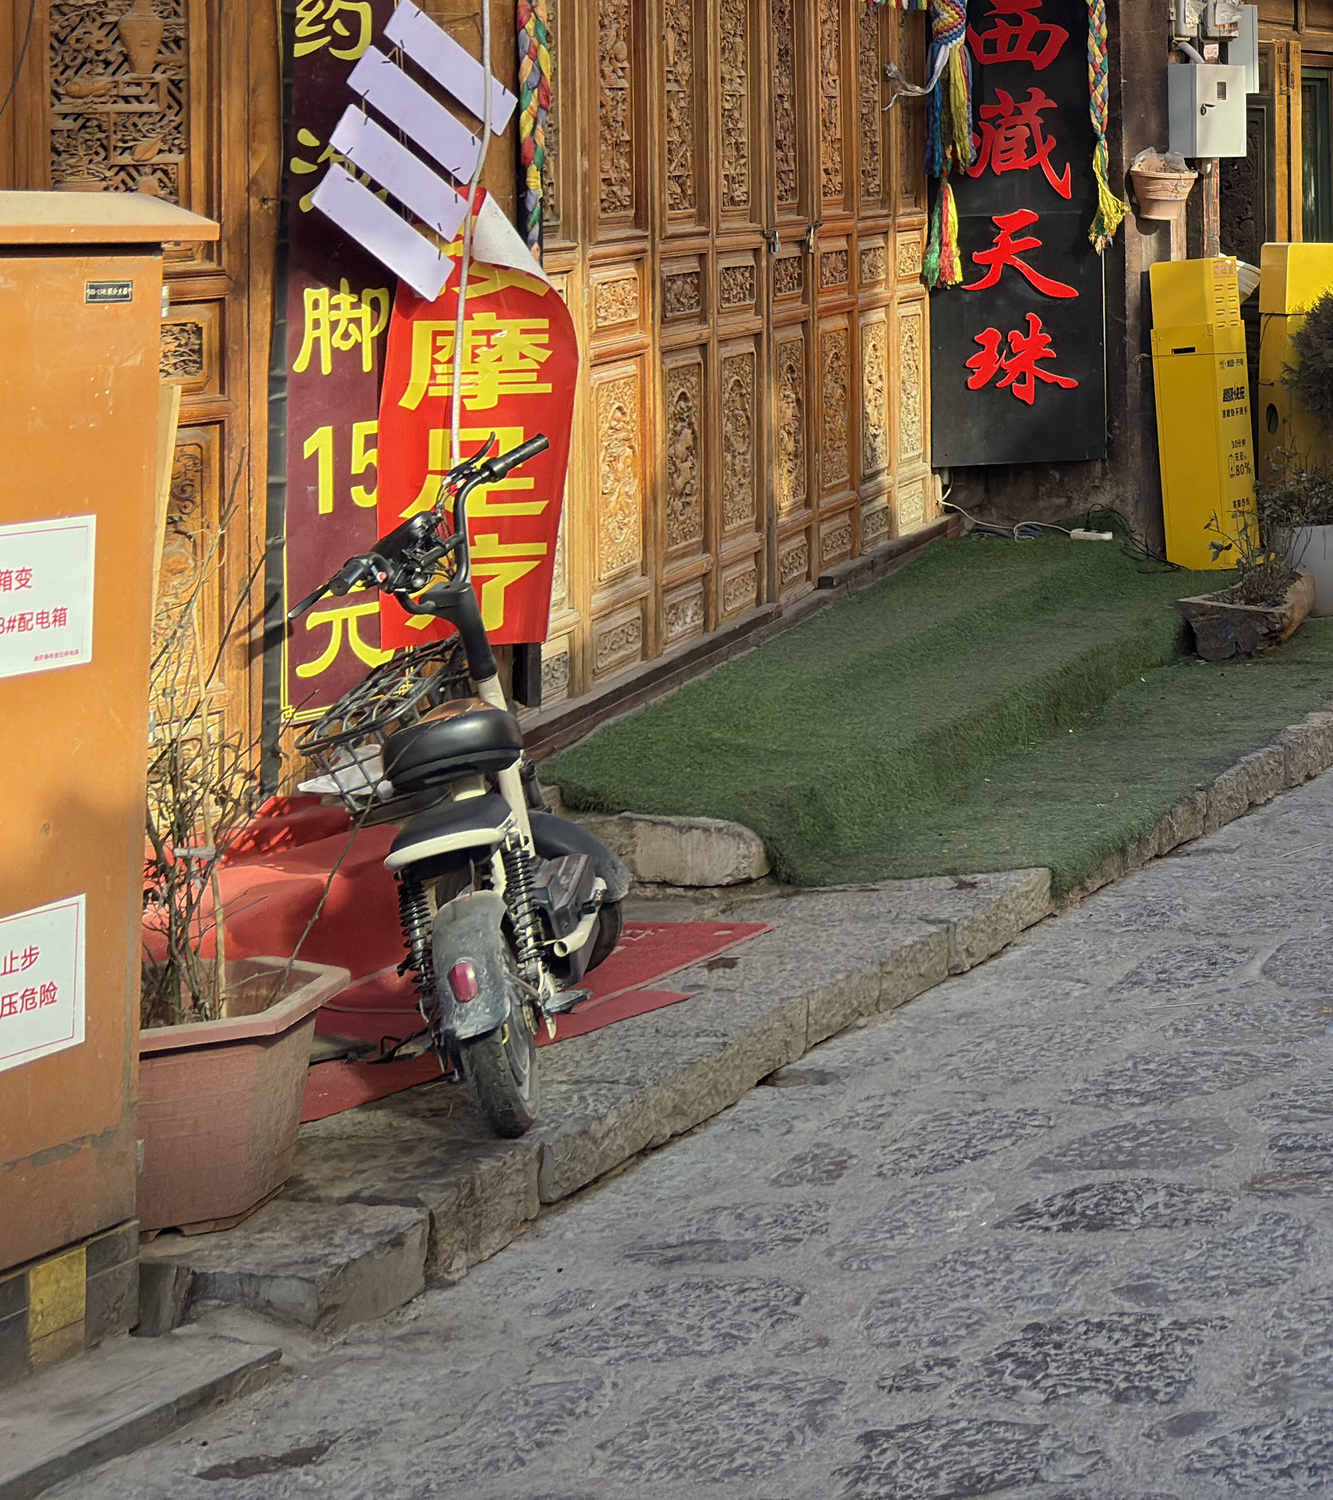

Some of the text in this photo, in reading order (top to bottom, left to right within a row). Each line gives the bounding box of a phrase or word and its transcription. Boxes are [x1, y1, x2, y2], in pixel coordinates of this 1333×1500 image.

[398, 205, 553, 632] 摩足疗
[0, 567, 33, 592] 箱变
[0, 945, 40, 976] 止步
[0, 981, 58, 1019] 压危险
